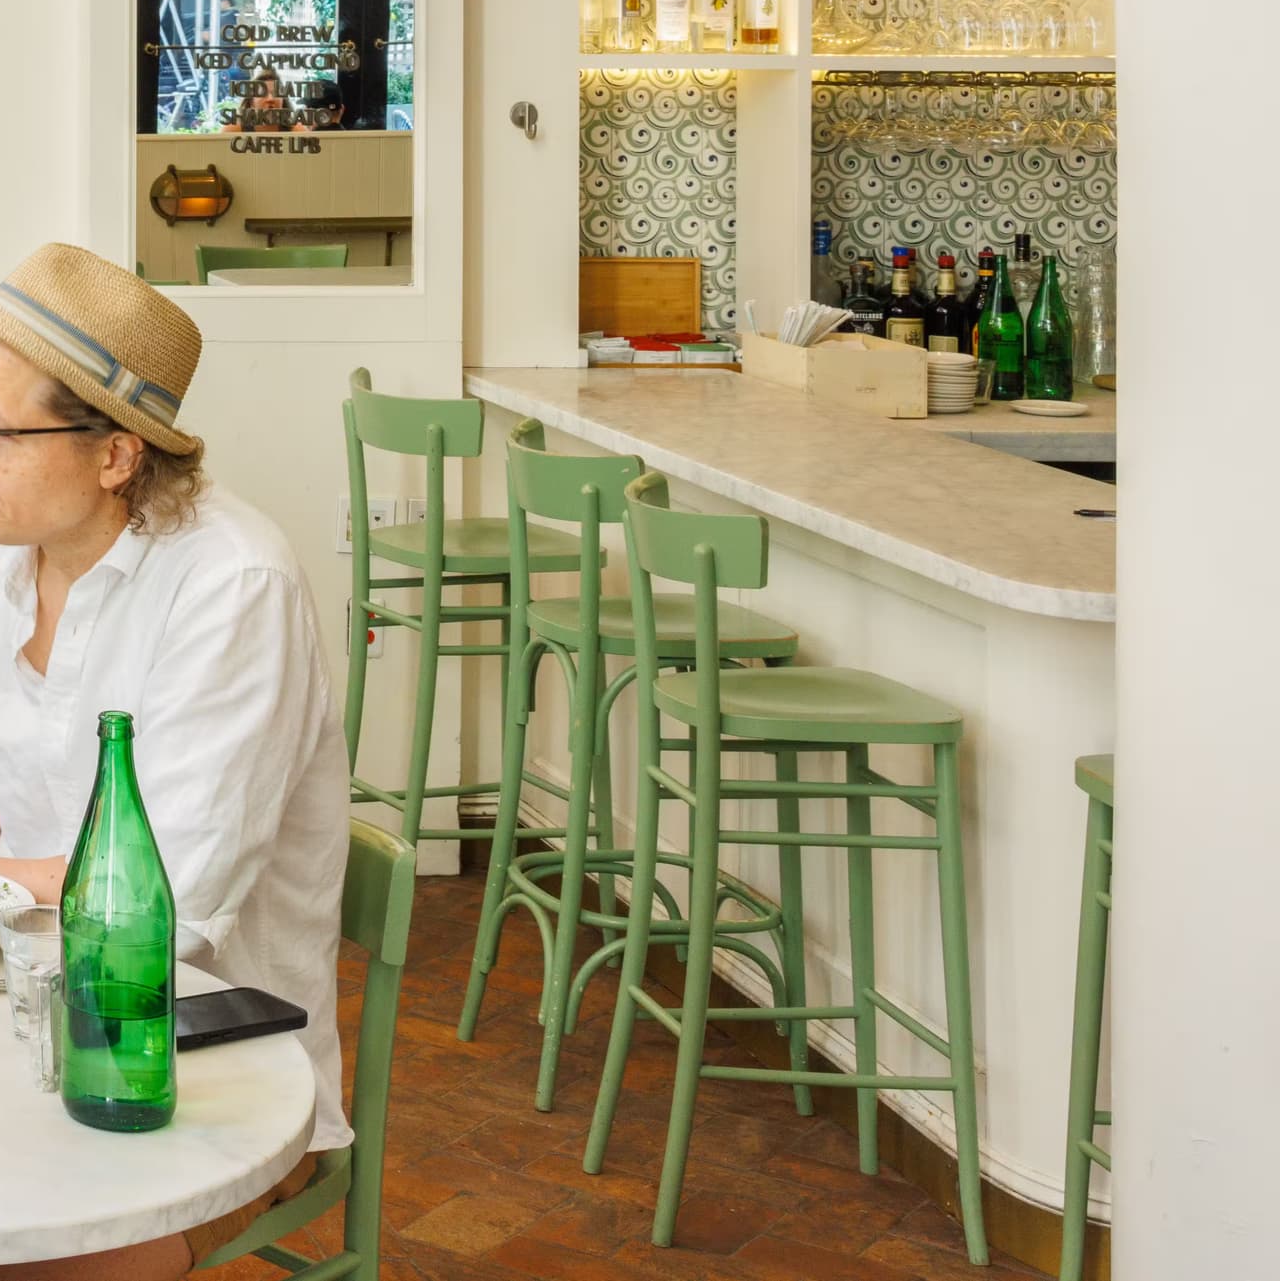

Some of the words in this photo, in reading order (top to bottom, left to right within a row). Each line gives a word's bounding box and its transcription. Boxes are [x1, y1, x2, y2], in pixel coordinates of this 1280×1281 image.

[221, 24, 271, 43] COLD
[276, 24, 335, 43] BREW
[195, 52, 234, 70] ICED
[237, 51, 360, 71] CAPPUCCINO
[230, 80, 268, 98] ICED
[273, 80, 324, 98] LATTE
[220, 107, 333, 126] SHAKERATO
[289, 136, 322, 154] LPB
